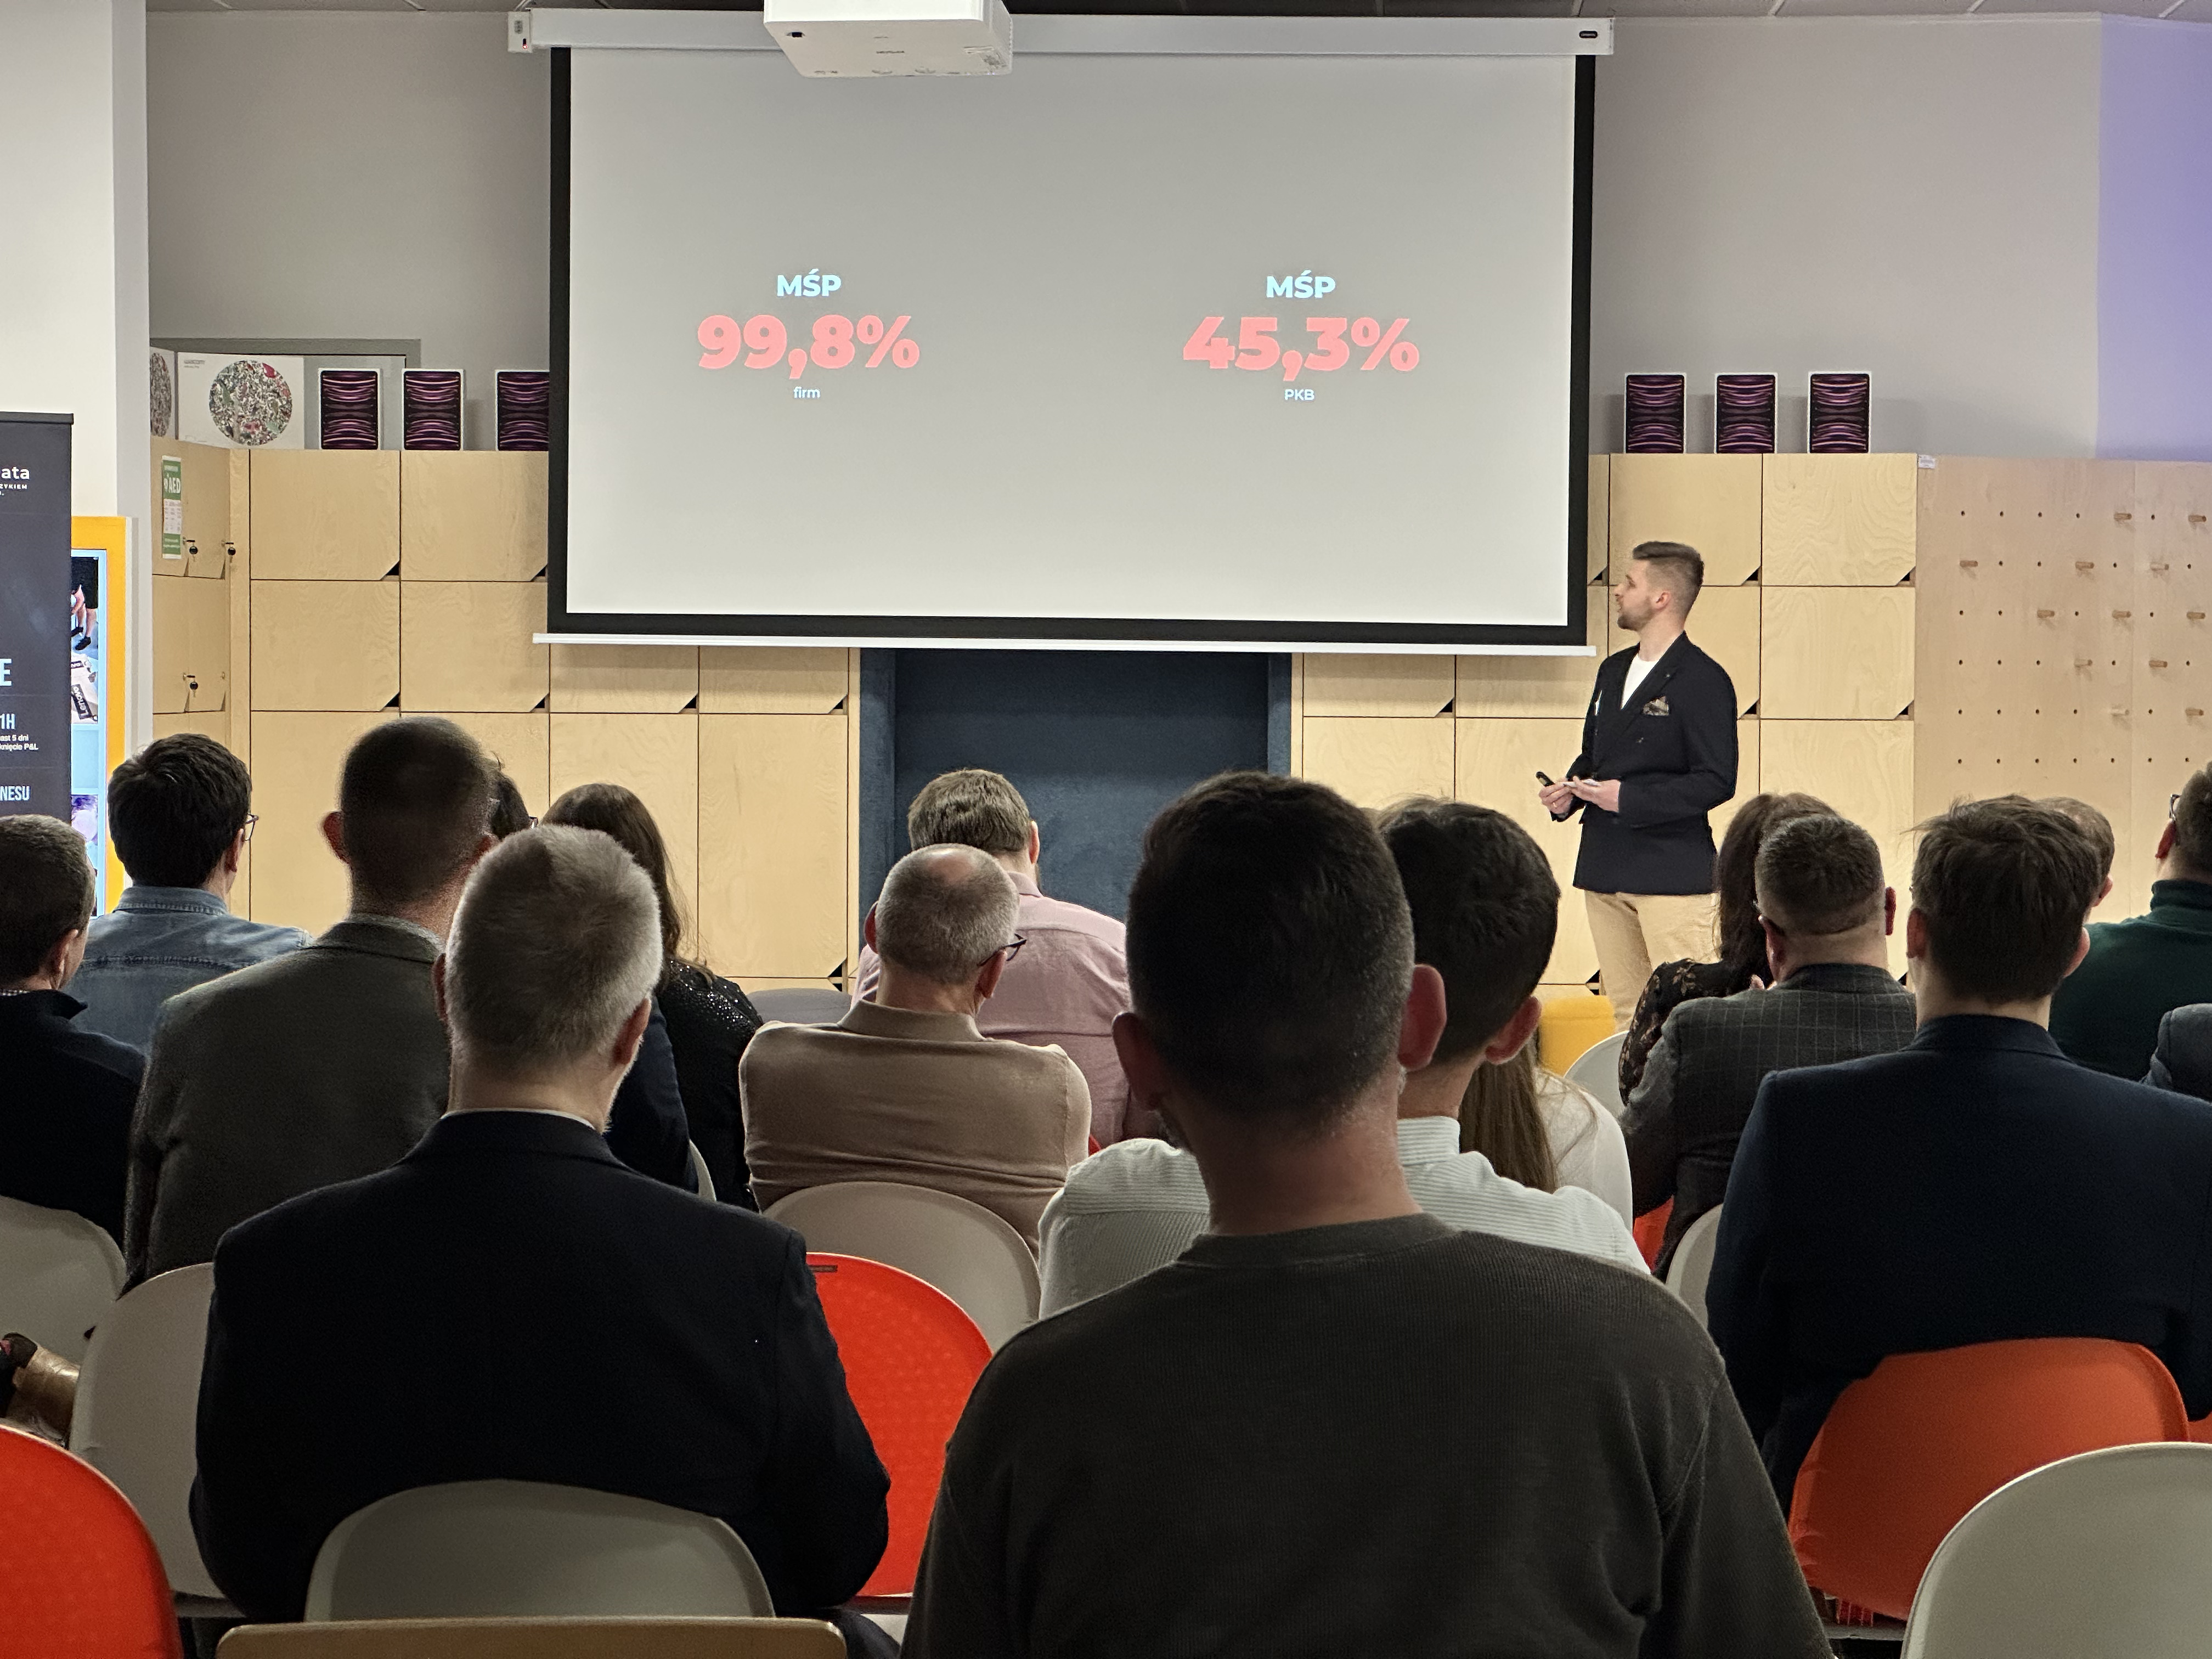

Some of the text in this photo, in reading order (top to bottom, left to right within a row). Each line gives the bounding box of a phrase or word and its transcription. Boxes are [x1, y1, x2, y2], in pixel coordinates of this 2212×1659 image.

[777, 268, 842, 297] MŚP
[1266, 270, 1336, 299] MŚP
[698, 314, 920, 379] 99,8%
[1183, 316, 1419, 381] 45,3%
[793, 386, 821, 399] firm
[1284, 388, 1315, 401] PKB
[168, 477, 180, 494] AED
[0, 786, 30, 801] NESU
